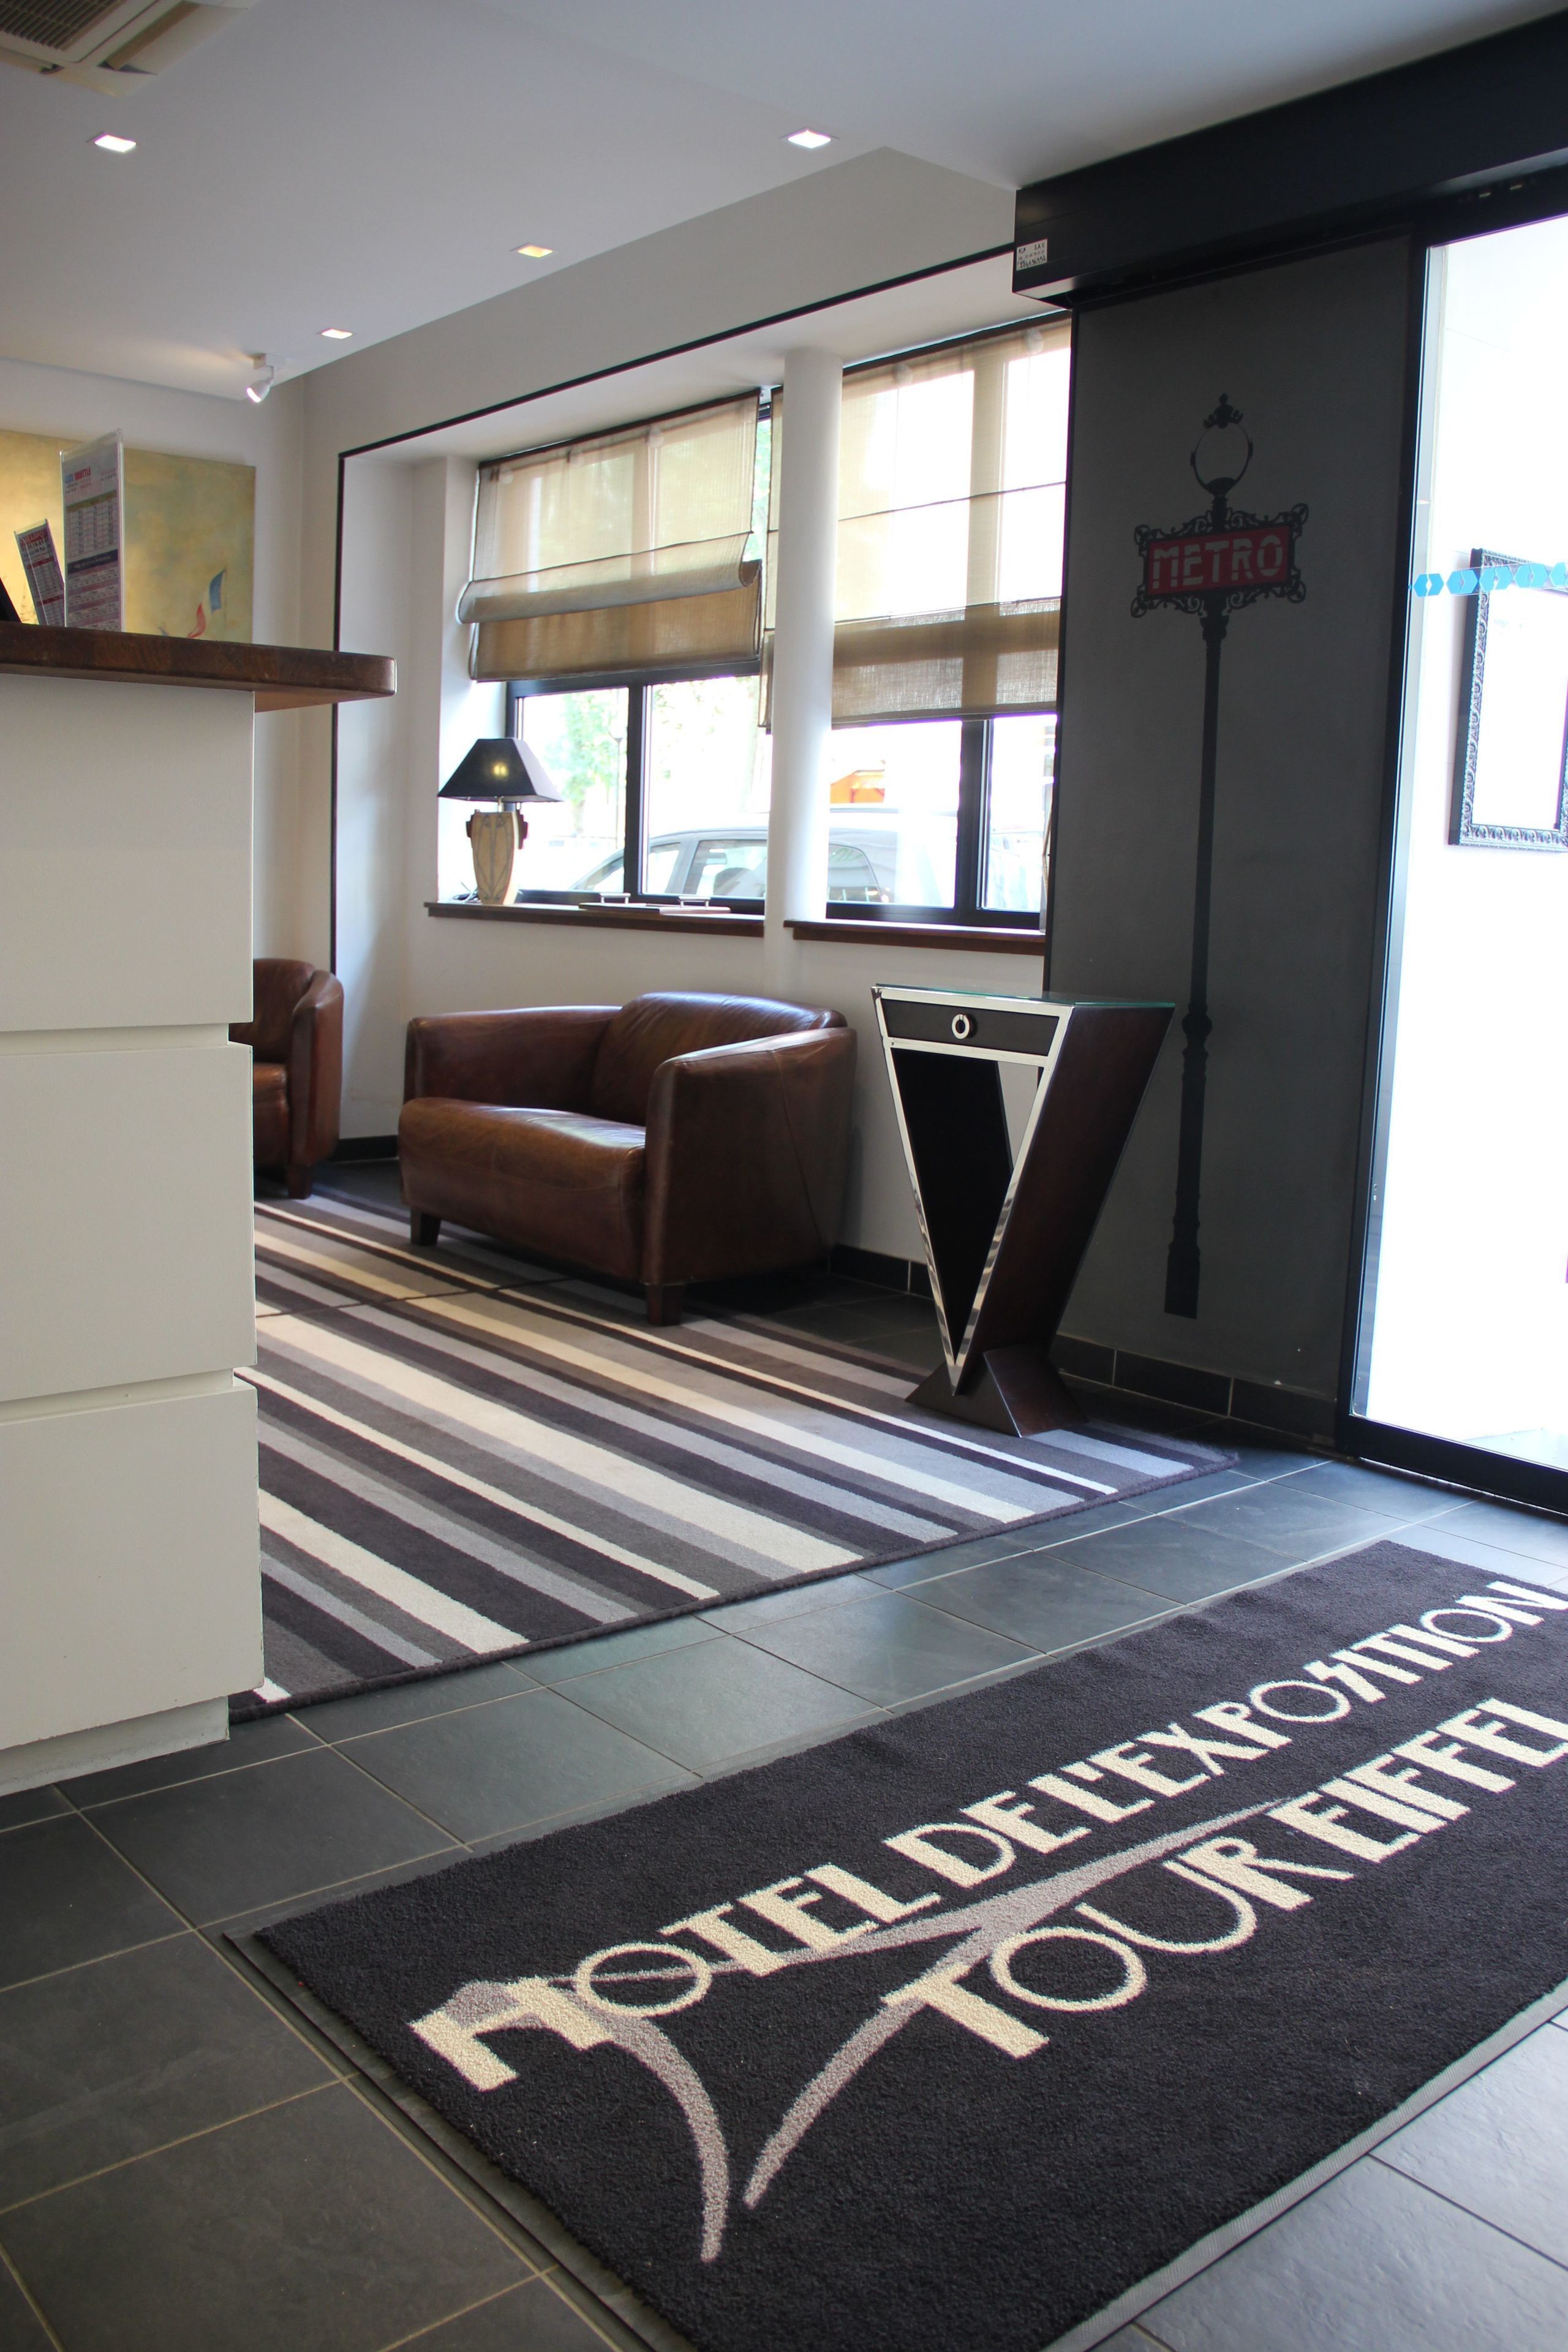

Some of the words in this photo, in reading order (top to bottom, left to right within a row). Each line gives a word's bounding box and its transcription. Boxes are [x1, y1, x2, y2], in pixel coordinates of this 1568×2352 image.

[1152, 535, 1283, 589] METRO
[409, 1863, 941, 2092] HOTEL
[883, 1790, 1092, 1888] DE
[881, 1836, 1355, 2059] TOUR
